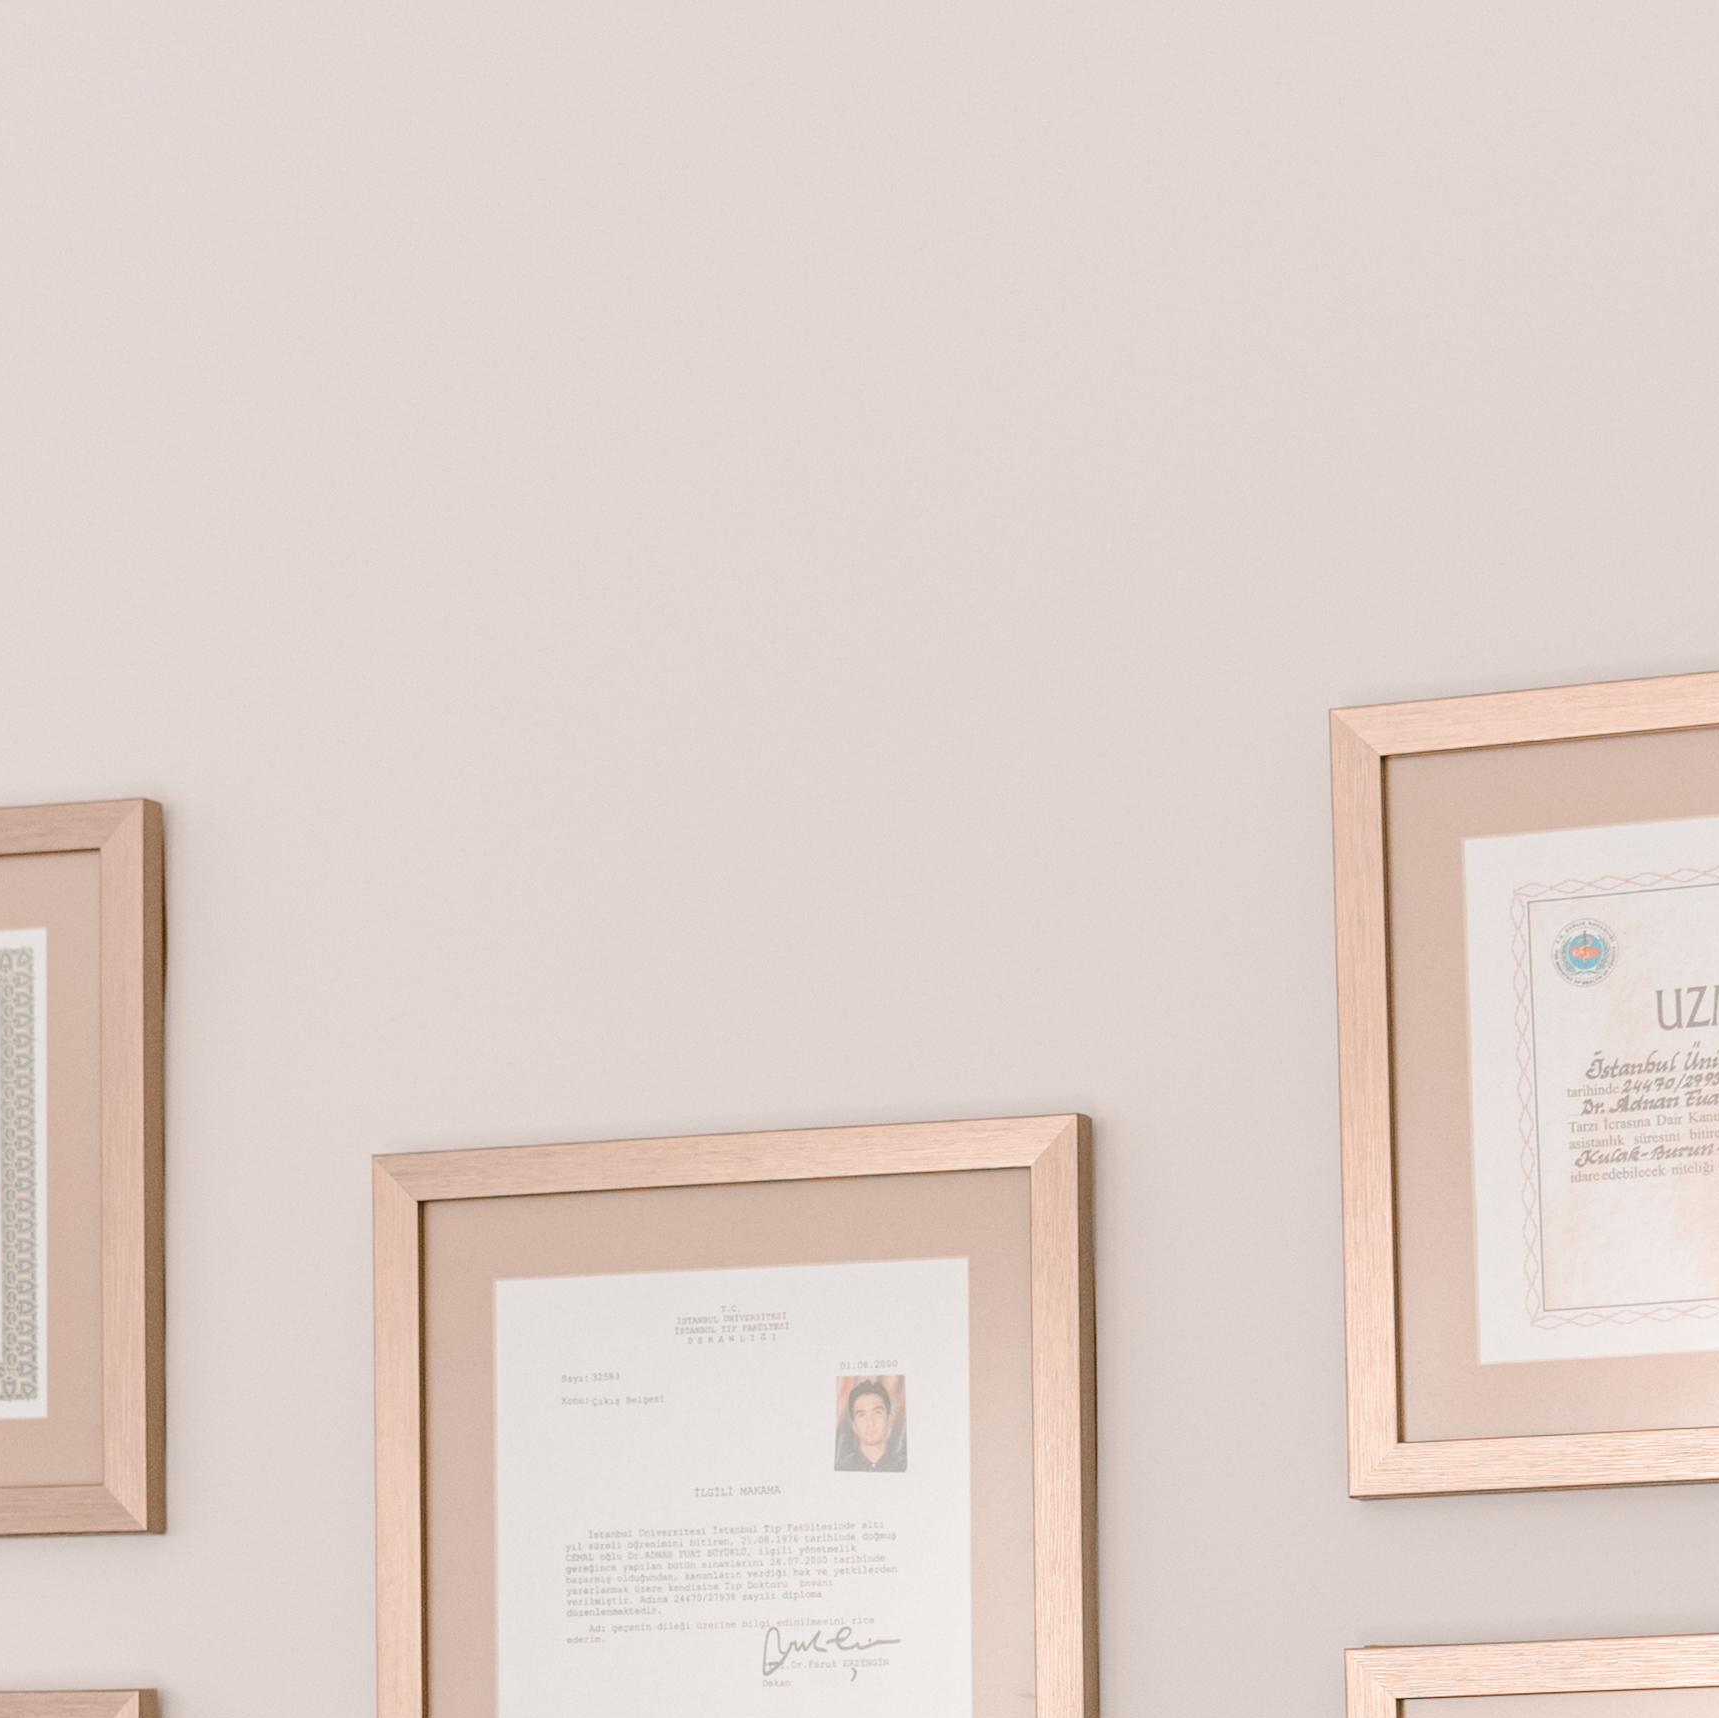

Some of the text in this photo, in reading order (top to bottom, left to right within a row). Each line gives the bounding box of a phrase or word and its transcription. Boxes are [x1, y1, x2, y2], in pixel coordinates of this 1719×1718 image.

[1585, 1050, 1680, 1080] İstanbul
[1567, 1082, 1620, 1098] tarihinde
[1581, 1098, 1605, 1115] Dr.
[1608, 1091, 1679, 1114] Adnan
[1571, 1171, 1600, 1183] idare
[1602, 1164, 1666, 1180] edebilecek
[1672, 1160, 1715, 1176] niteliği
[721, 1305, 740, 1313] T.C.
[677, 1316, 718, 1325] İSTANBUL
[675, 1327, 716, 1335] İSTANBUL
[626, 1395, 664, 1405] Belgesi
[695, 1485, 781, 1498] İLGİLİ MAKAMA
[589, 1529, 632, 1539] İstanbul
[713, 1525, 757, 1535] İstanbul
[763, 1524, 781, 1534] Tıp
[787, 1522, 856, 1532] Fakültesinde
[862, 1521, 884, 1529] altı
[742, 1592, 775, 1602] sayılı
[782, 1591, 822, 1600] diploma
